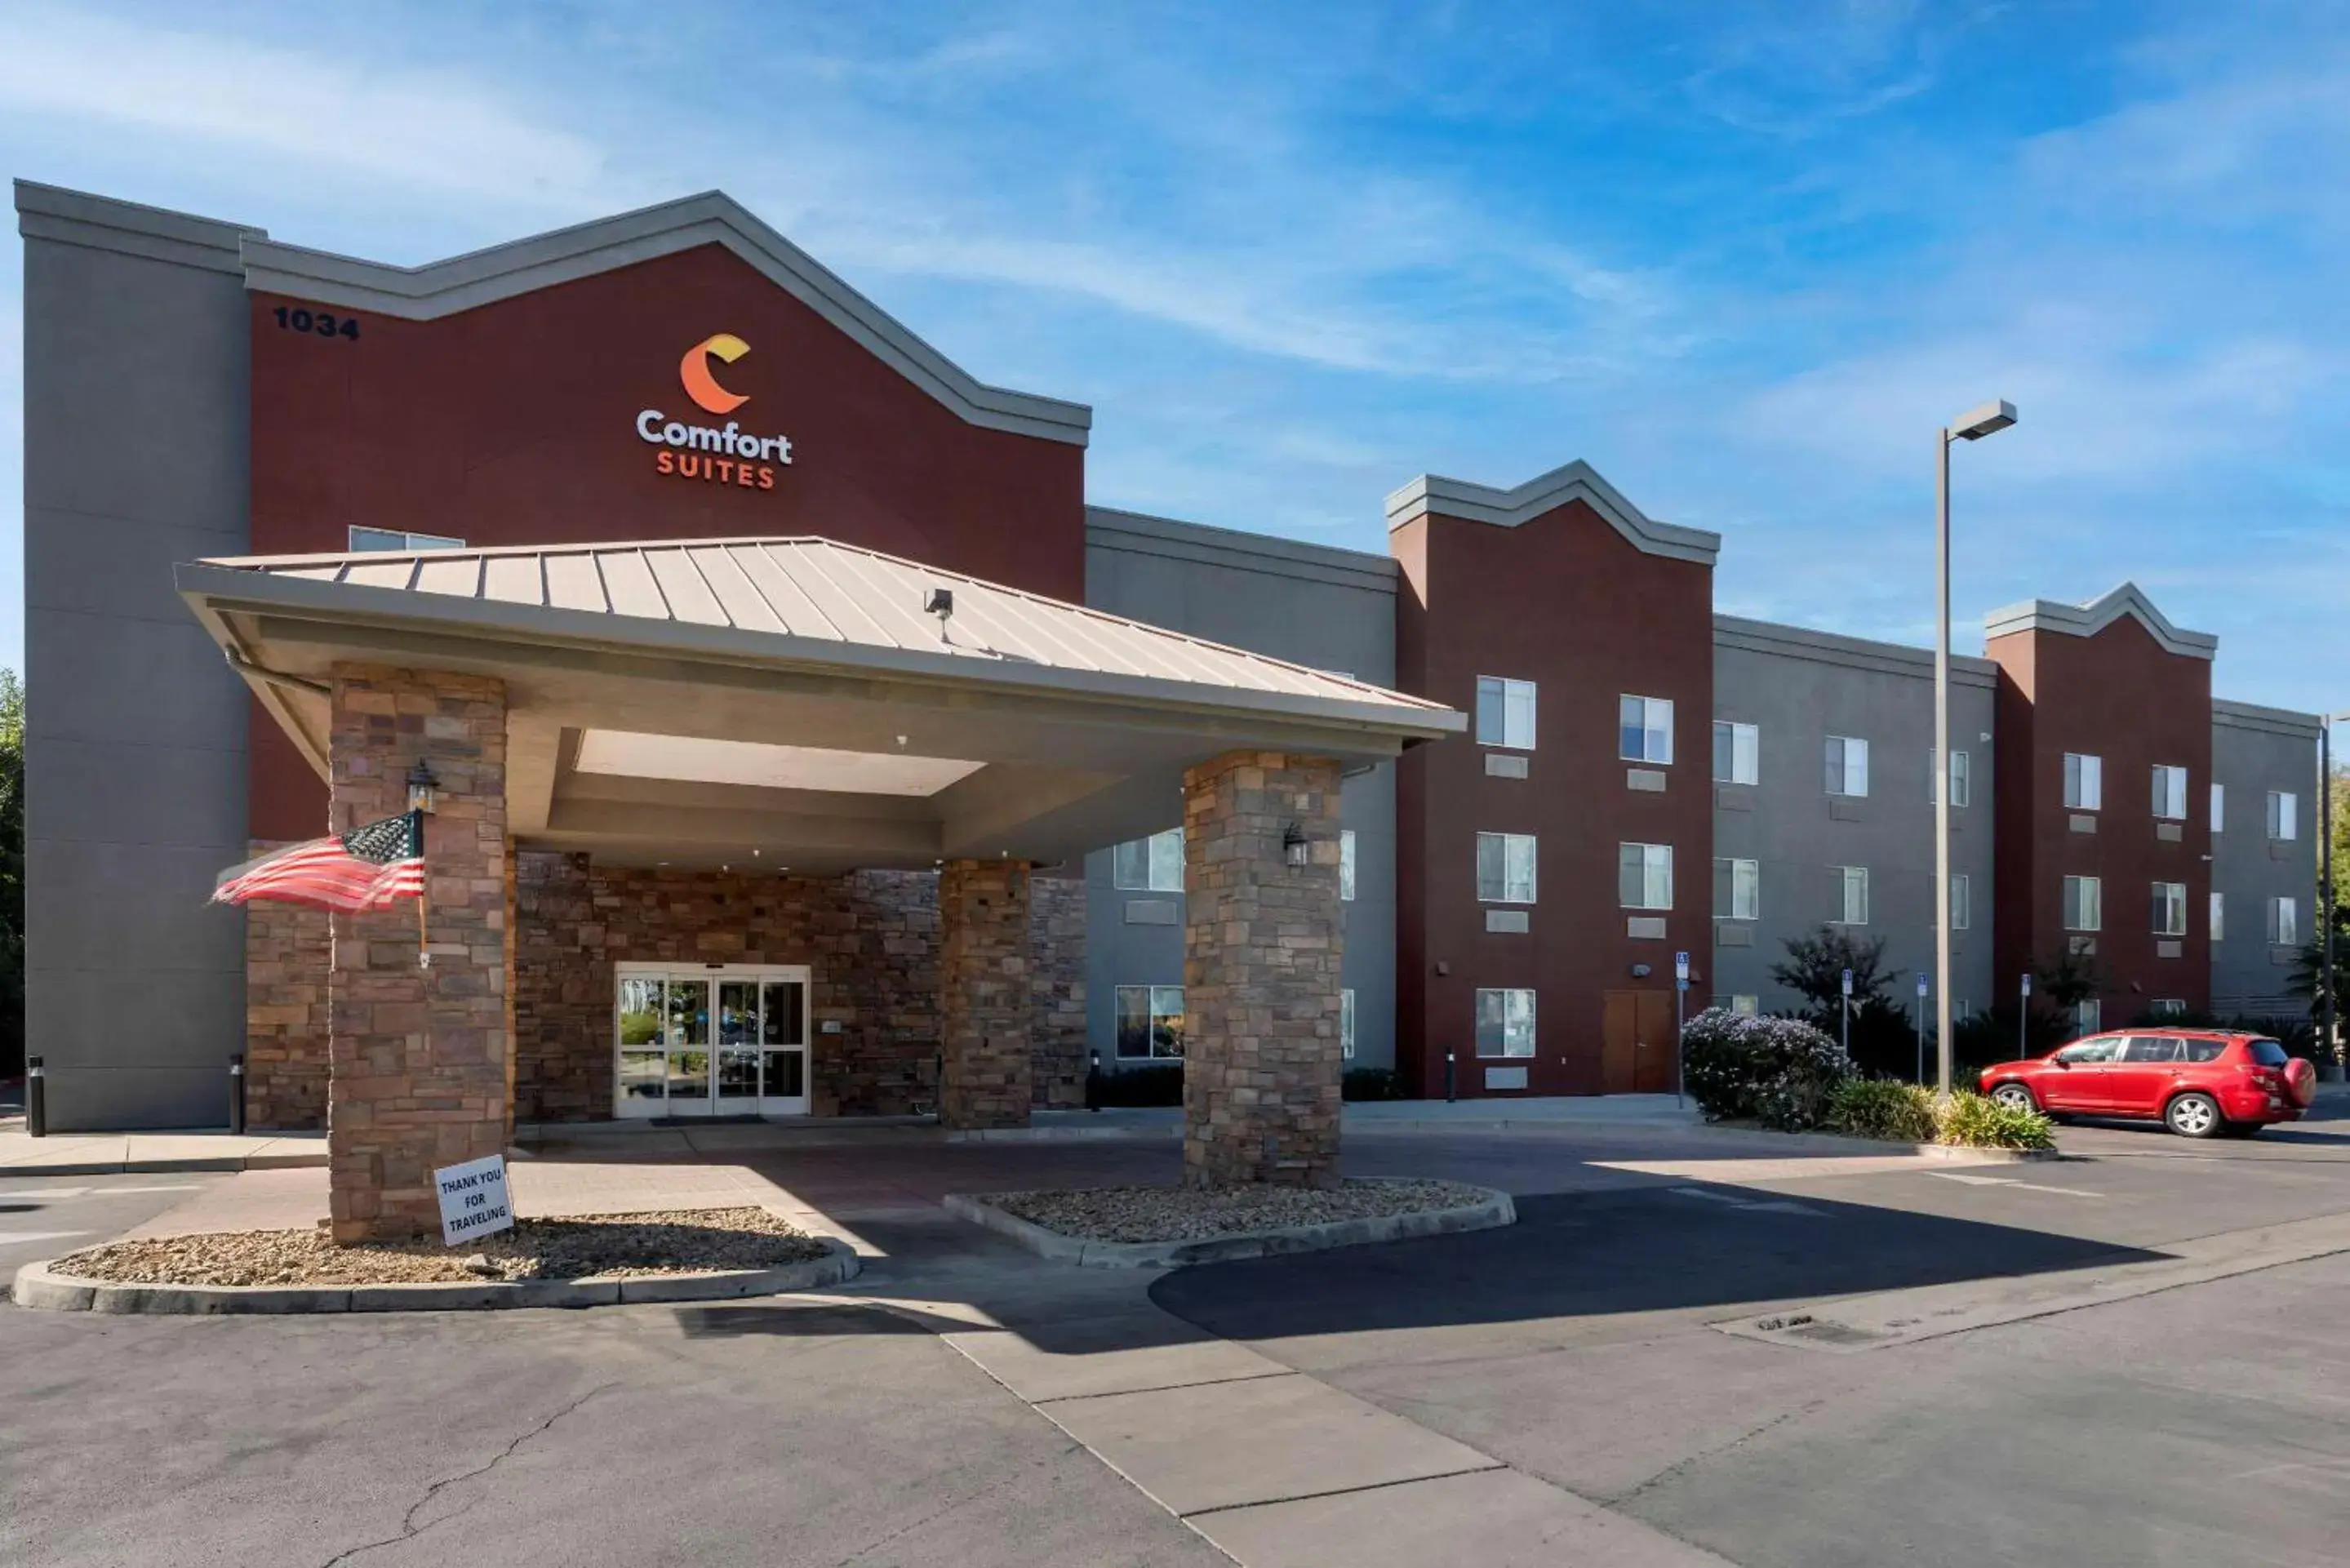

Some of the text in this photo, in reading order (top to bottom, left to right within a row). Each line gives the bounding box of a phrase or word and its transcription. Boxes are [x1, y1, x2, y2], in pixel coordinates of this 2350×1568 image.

[273, 306, 359, 340] 1034
[636, 409, 792, 464] Comfort
[656, 451, 774, 489] SUITES
[442, 1169, 500, 1193] THANK YOU
[464, 1193, 486, 1208] FOR
[449, 1206, 506, 1232] TRAVELING
